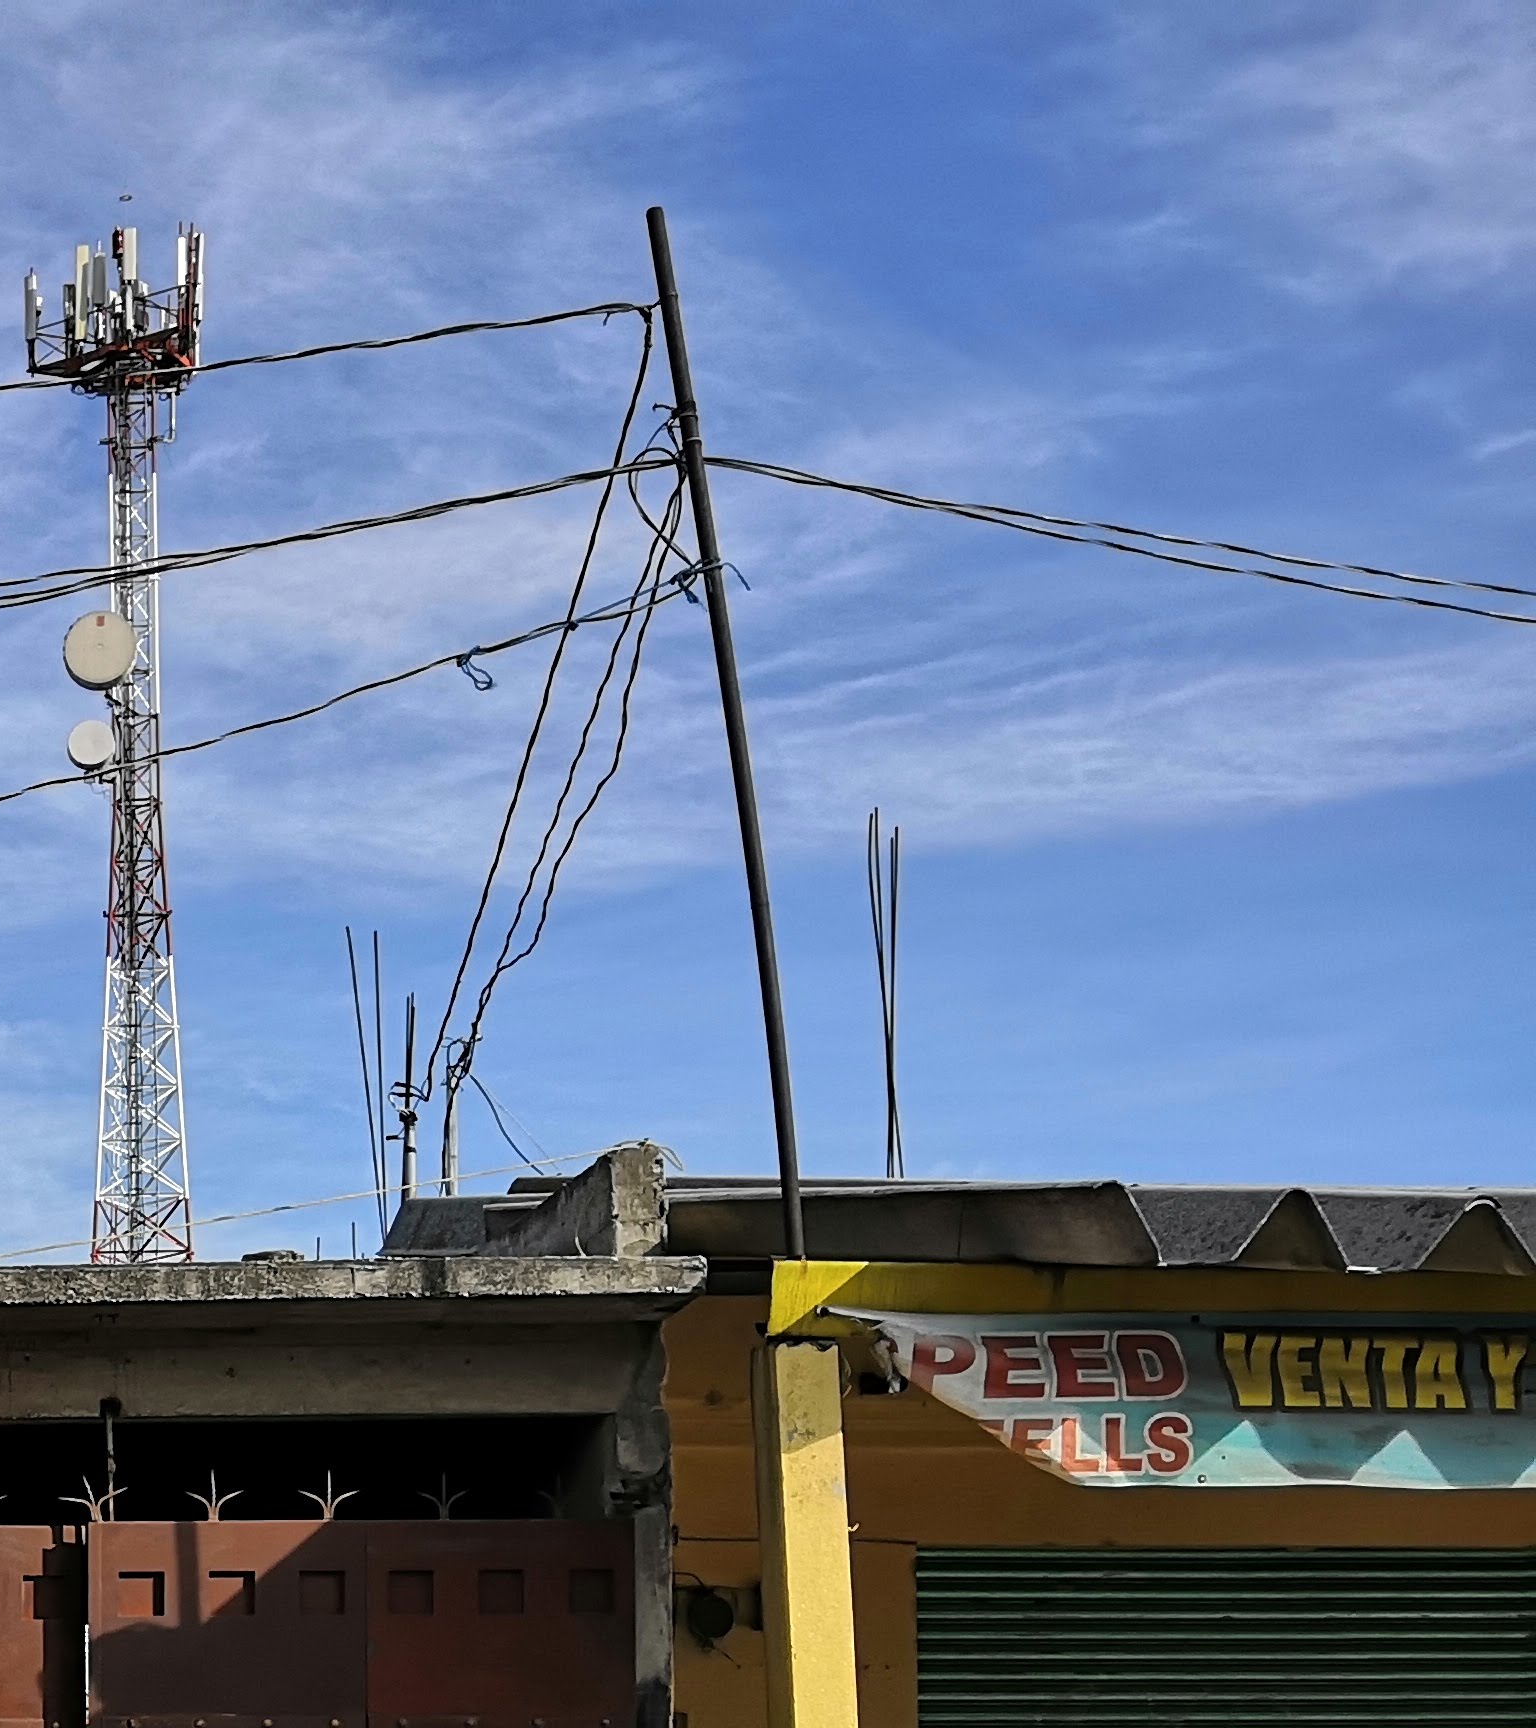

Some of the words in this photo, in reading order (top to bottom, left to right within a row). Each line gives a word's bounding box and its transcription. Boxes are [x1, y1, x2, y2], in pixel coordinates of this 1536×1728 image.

[890, 1332, 1186, 1400] PEED
[1219, 1331, 1468, 1411] VENTA
[1481, 1333, 1528, 1411] Y
[981, 1416, 1190, 1474] ELLS
